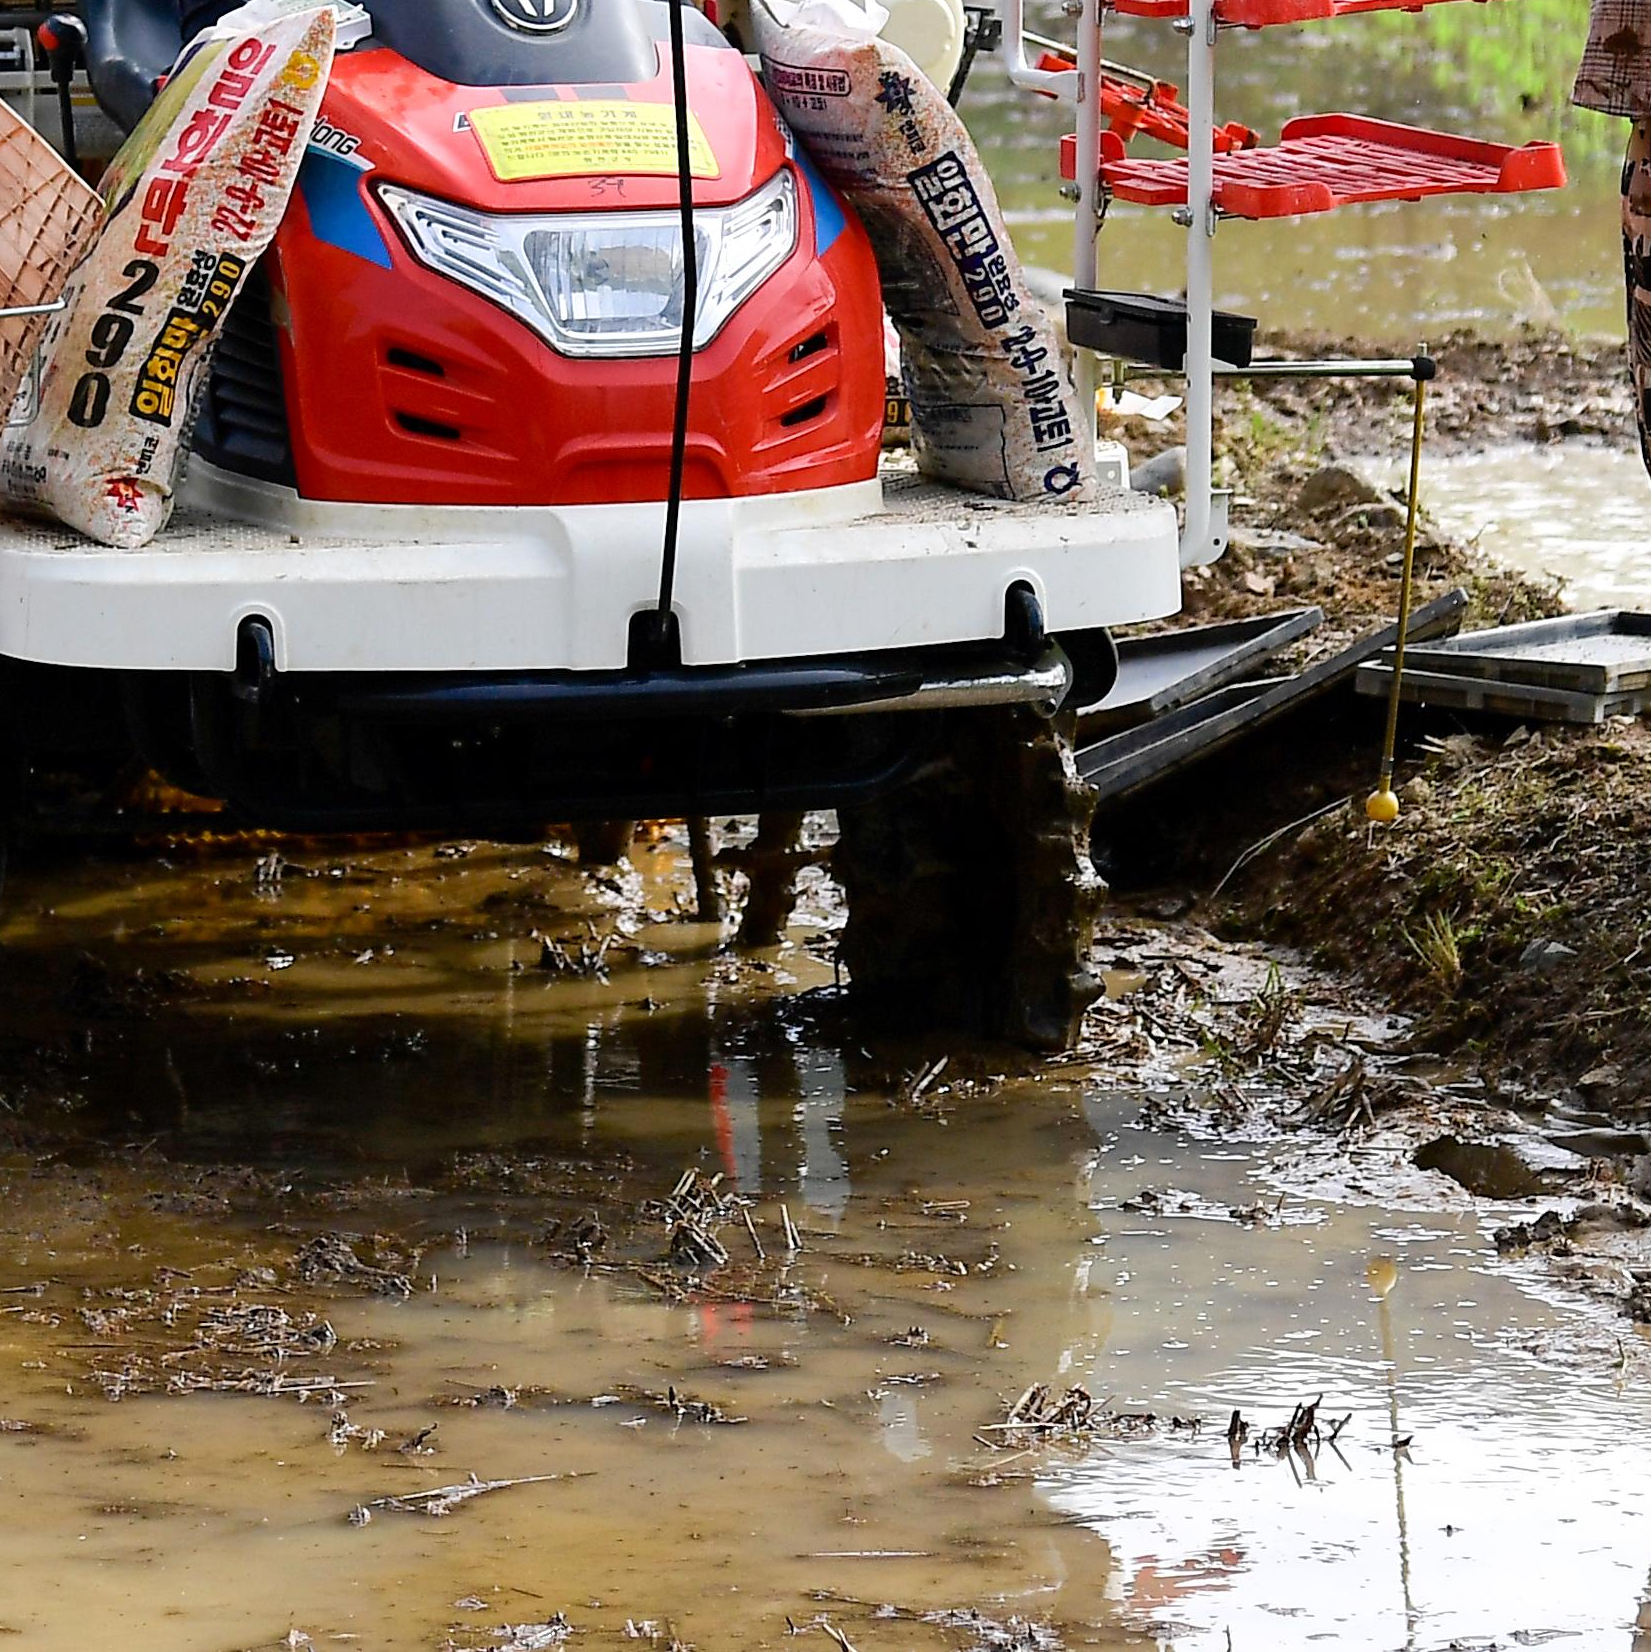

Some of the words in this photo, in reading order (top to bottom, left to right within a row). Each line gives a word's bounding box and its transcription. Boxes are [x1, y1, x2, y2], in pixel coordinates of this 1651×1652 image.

[135, 37, 277, 257] 일회만
[914, 159, 994, 259] 일회만
[176, 250, 217, 307] 완효성
[203, 261, 240, 318] 290
[965, 267, 1004, 322] 290
[67, 259, 160, 428] 290
[136, 314, 208, 418] 일회만
